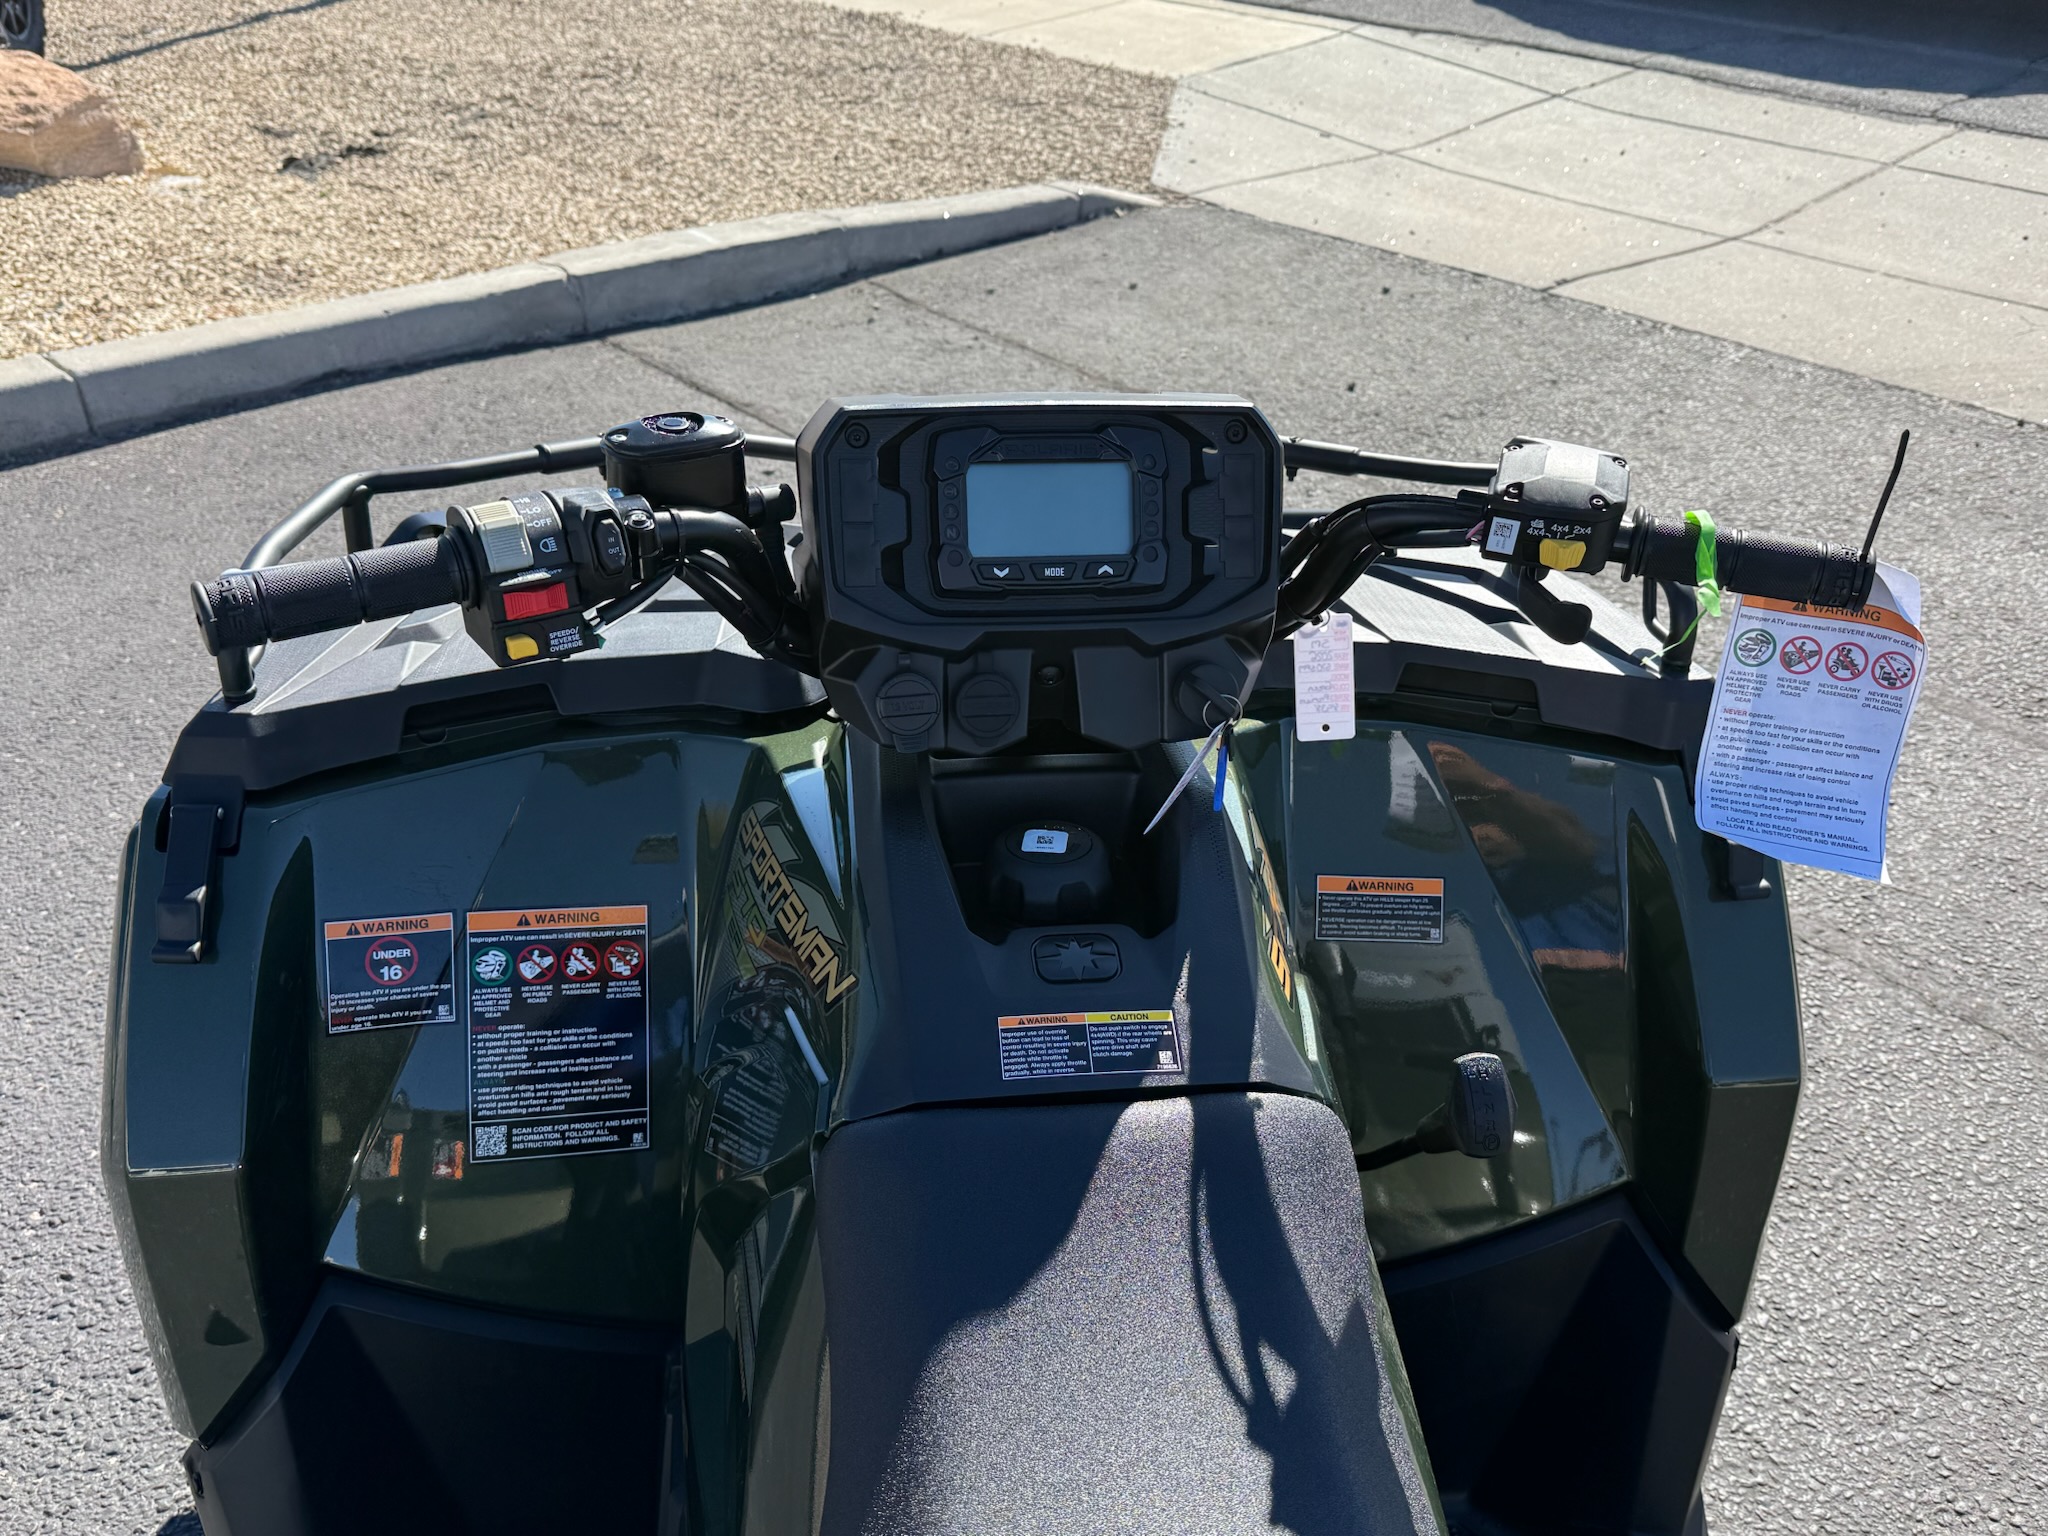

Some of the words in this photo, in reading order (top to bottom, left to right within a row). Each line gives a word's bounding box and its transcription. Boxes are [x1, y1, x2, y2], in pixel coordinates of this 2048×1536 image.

[533, 518, 552, 527] OFF
[1527, 528, 1545, 536] 4x4
[1551, 524, 1569, 533] 4x4
[1573, 526, 1592, 534] 2x4
[1044, 567, 1065, 577] MODE
[549, 626, 579, 639] SPEEDO/
[1740, 612, 1770, 623] Improper
[1811, 623, 1830, 631] result
[1837, 627, 1865, 637] SEVERE
[1865, 632, 1891, 642] INJURY
[1899, 640, 1923, 652] DEATH
[550, 634, 580, 645] REVERSE
[550, 640, 583, 652] OVERRIDE
[1722, 708, 1747, 716] NEVER
[1748, 711, 1775, 721] operate:
[1723, 716, 1748, 725] without
[1749, 721, 1771, 729] proper
[1772, 723, 1798, 733] training
[1808, 728, 1844, 739] instruction
[1725, 816, 1754, 825] LOCATE
[1755, 820, 1771, 828] AND
[1771, 823, 1791, 832] READ
[1792, 827, 1826, 837] OWNER'S
[1826, 833, 1858, 843] MANUAL.
[1715, 820, 1745, 830] FOLLOW
[1746, 825, 1760, 833] ALL
[1760, 828, 1813, 842] INSTRUCTIONS
[1813, 836, 1829, 845] AND
[1829, 840, 1870, 852] WARNINGS.
[1358, 881, 1413, 891] WARNING
[741, 806, 857, 1004] SPORTSMAN
[534, 911, 599, 924] WARNING
[362, 918, 428, 933] WARNING
[372, 948, 410, 959] UNDER
[379, 964, 402, 981] 16
[330, 991, 358, 999] Operating
[1025, 1016, 1067, 1024] WARNING
[527, 1029, 551, 1037] training
[570, 1121, 603, 1129] PRODUCT
[621, 1117, 646, 1125] SAFETY
[512, 1132, 561, 1142] INFORMATION.
[565, 1129, 594, 1137] FOLLOW
[512, 1140, 562, 1149] INSTRUCTIONS
[581, 1135, 619, 1143] WARNINGS.
